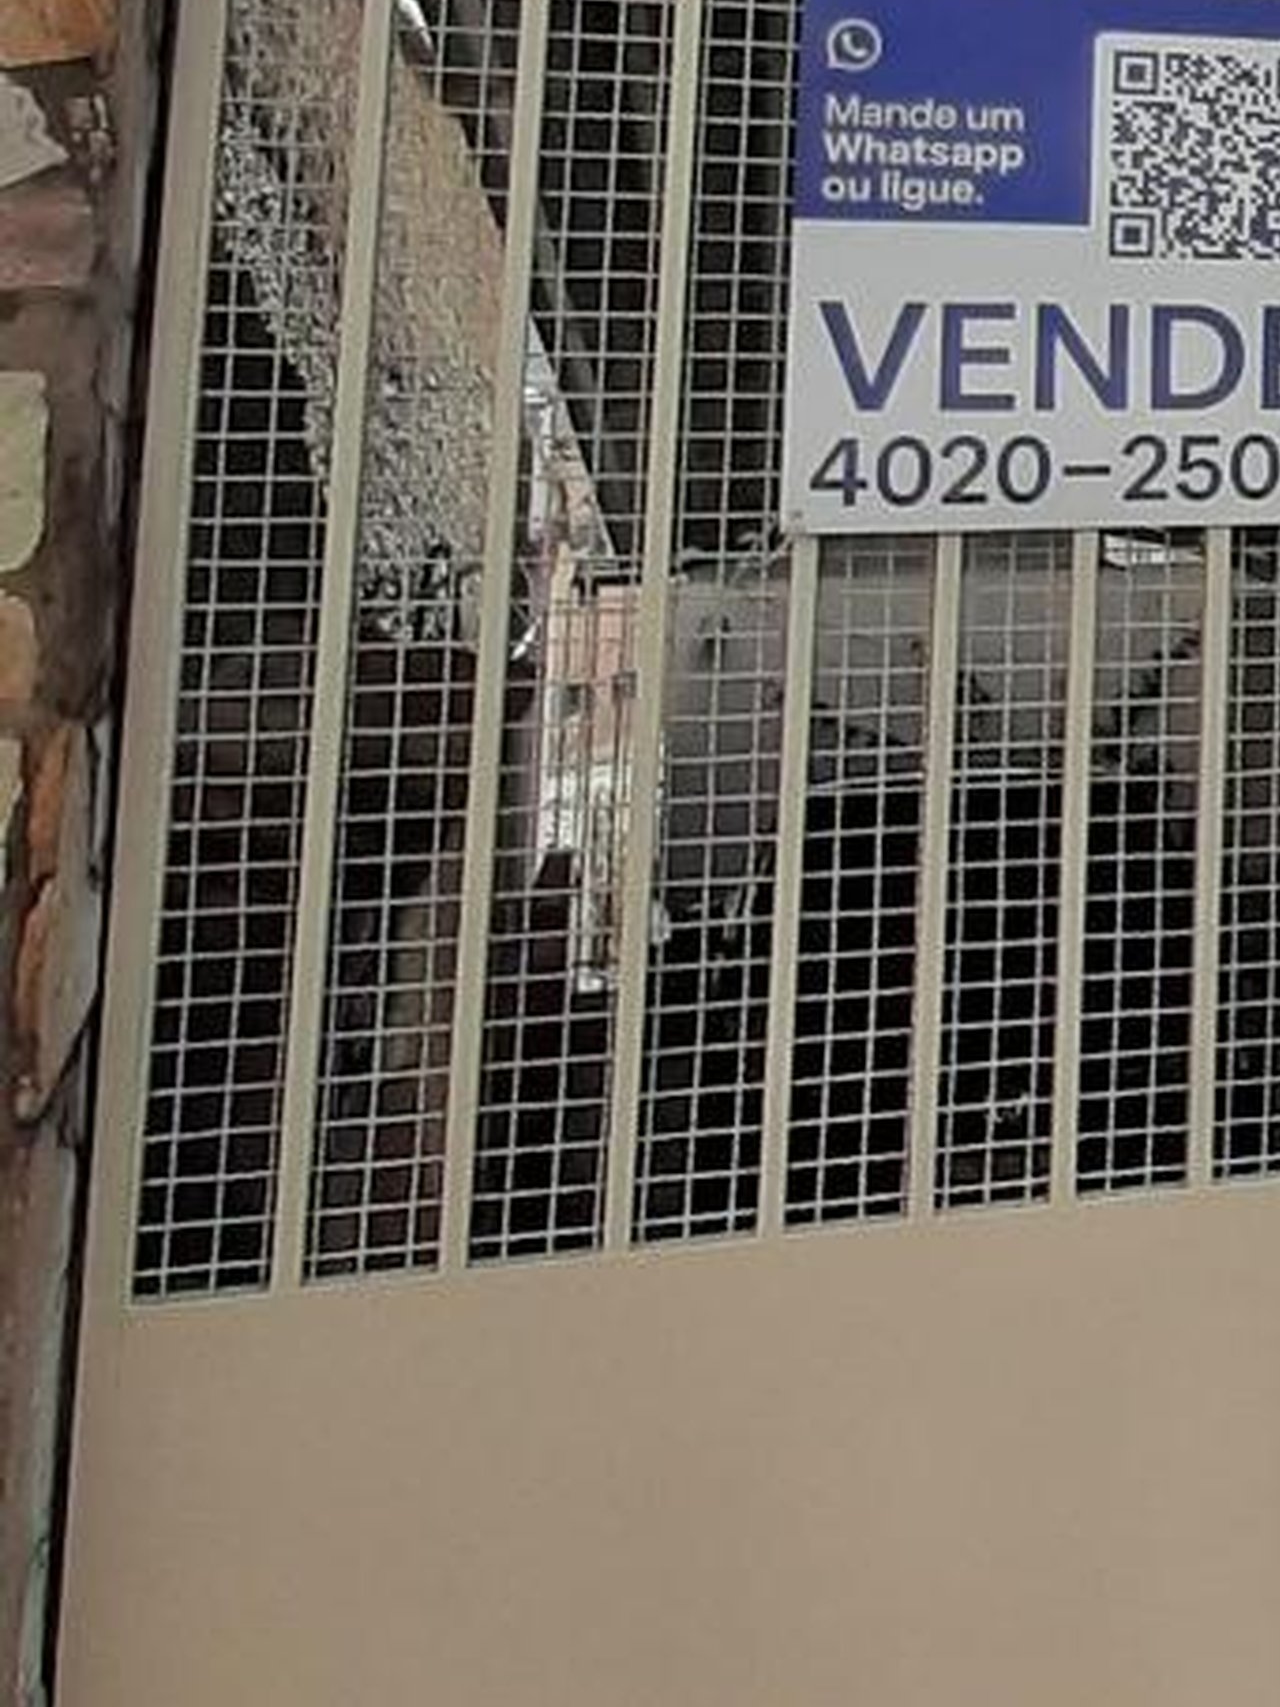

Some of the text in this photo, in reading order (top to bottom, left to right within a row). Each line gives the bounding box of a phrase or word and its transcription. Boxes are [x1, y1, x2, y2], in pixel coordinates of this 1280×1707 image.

[826, 95, 1025, 131] Mande um
[826, 133, 1025, 172] Whatsapp
[822, 172, 984, 210] ou ligue.
